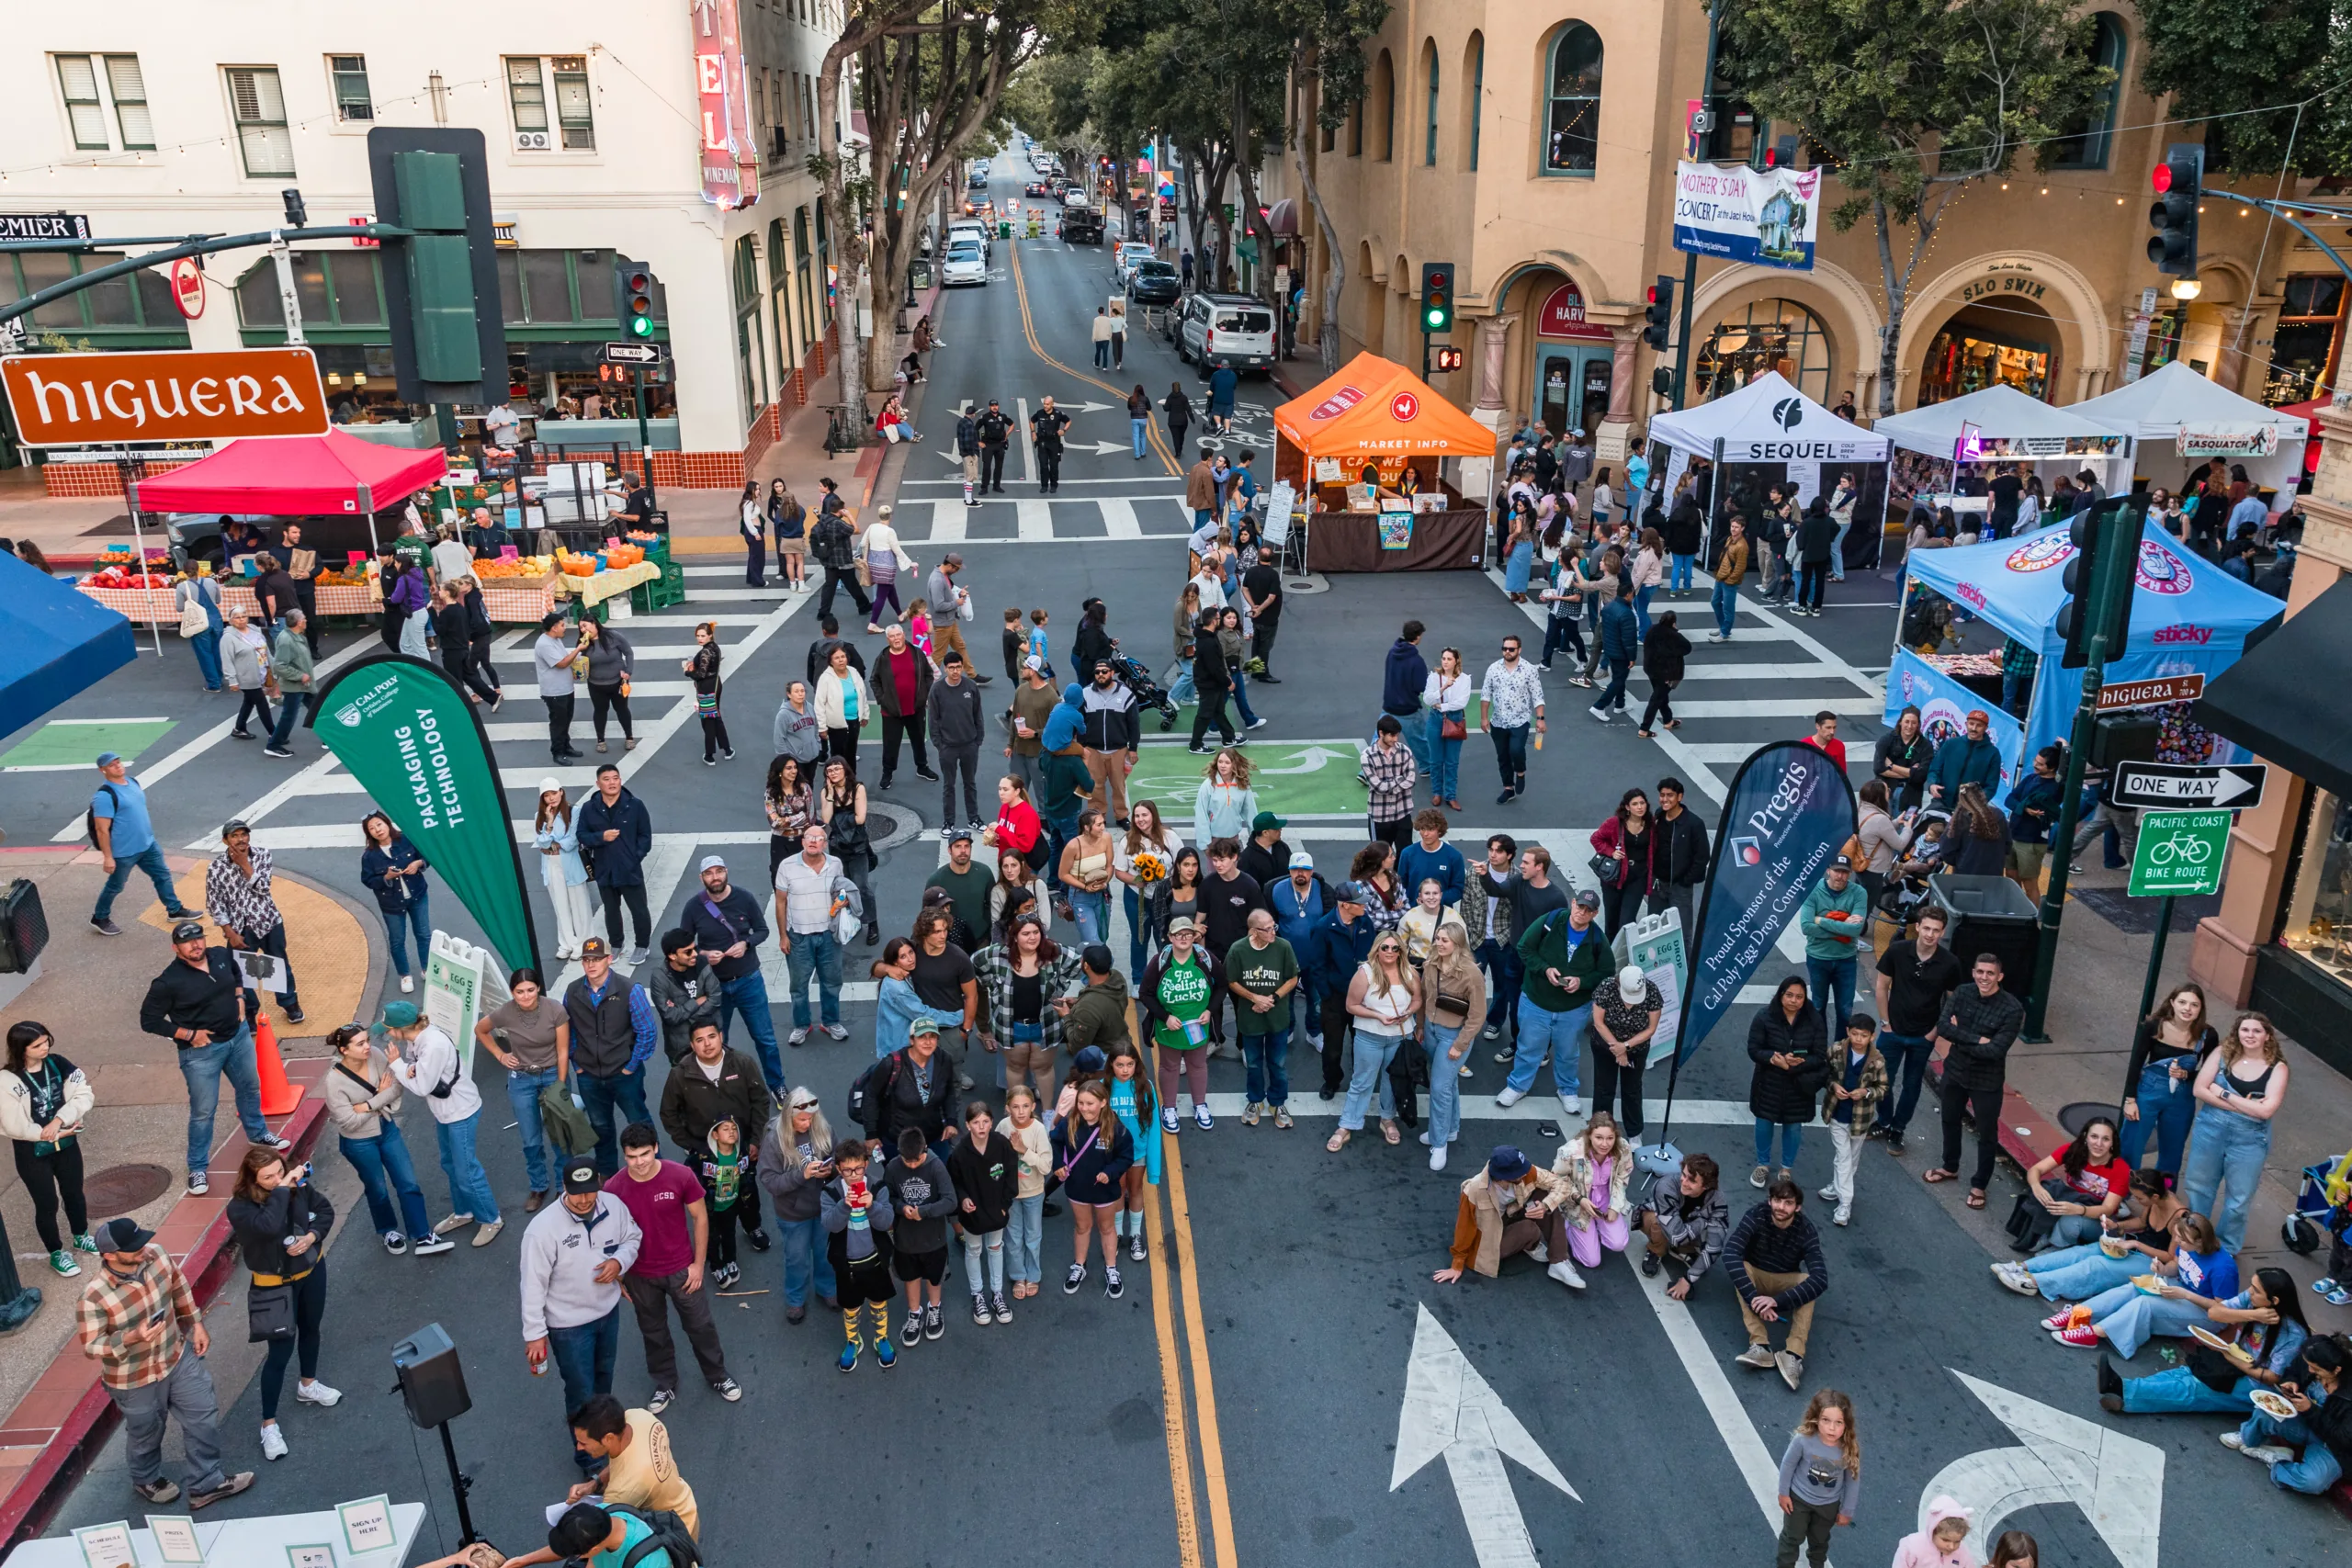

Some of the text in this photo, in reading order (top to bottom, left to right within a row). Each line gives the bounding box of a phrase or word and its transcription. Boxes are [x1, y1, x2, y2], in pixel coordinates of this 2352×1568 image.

[704, 166, 738, 185] WINEMAN
[1728, 180, 1747, 198] DAY
[1678, 198, 1718, 222] CONCERT
[1963, 278, 2046, 301] SLO SWIM
[1556, 307, 1585, 321] HARV
[1565, 321, 1594, 331] Apparel
[1453, 353, 1461, 367] 8
[616, 366, 624, 382] 8
[1359, 440, 1448, 449] MARKET INFO
[1749, 443, 1837, 459] SEQUEL
[2188, 440, 2249, 448] SASQUATCH
[1346, 457, 1363, 467] CA
[1382, 457, 1403, 467] WE
[1379, 516, 1411, 526] BEST
[1957, 581, 1987, 611] sticky
[2153, 624, 2214, 645] sticky
[356, 674, 399, 706] CAL POLY
[2179, 688, 2189, 697] 700
[1944, 710, 1951, 718] in
[415, 708, 464, 829] TECHNOLOGY
[394, 725, 440, 829] PACKAGING
[2131, 777, 2219, 795] ONE WAY
[1747, 761, 1807, 840] Pregis
[1773, 775, 1820, 849] Protective Packaging Solutions
[2149, 816, 2225, 829] PACIFIC COAST
[2145, 866, 2209, 878] BIKE ROUTE
[1705, 856, 1792, 972] Proud Sponsor of the
[1703, 841, 1830, 1010] Cal Poly Egg Drop Competition
[1657, 942, 1672, 956] EGG
[1673, 939, 1682, 969] DROP
[450, 973, 466, 987] EGG
[1262, 969, 1281, 981] POLY
[465, 979, 473, 1012] DROP
[1162, 988, 1204, 1004] Lucky
[653, 1191, 675, 1201] UCSD
[901, 1183, 931, 1199] VANS
[351, 1520, 370, 1529] SIGN
[359, 1526, 379, 1535] HERE
[88, 1535, 121, 1545] SCHEDULE
